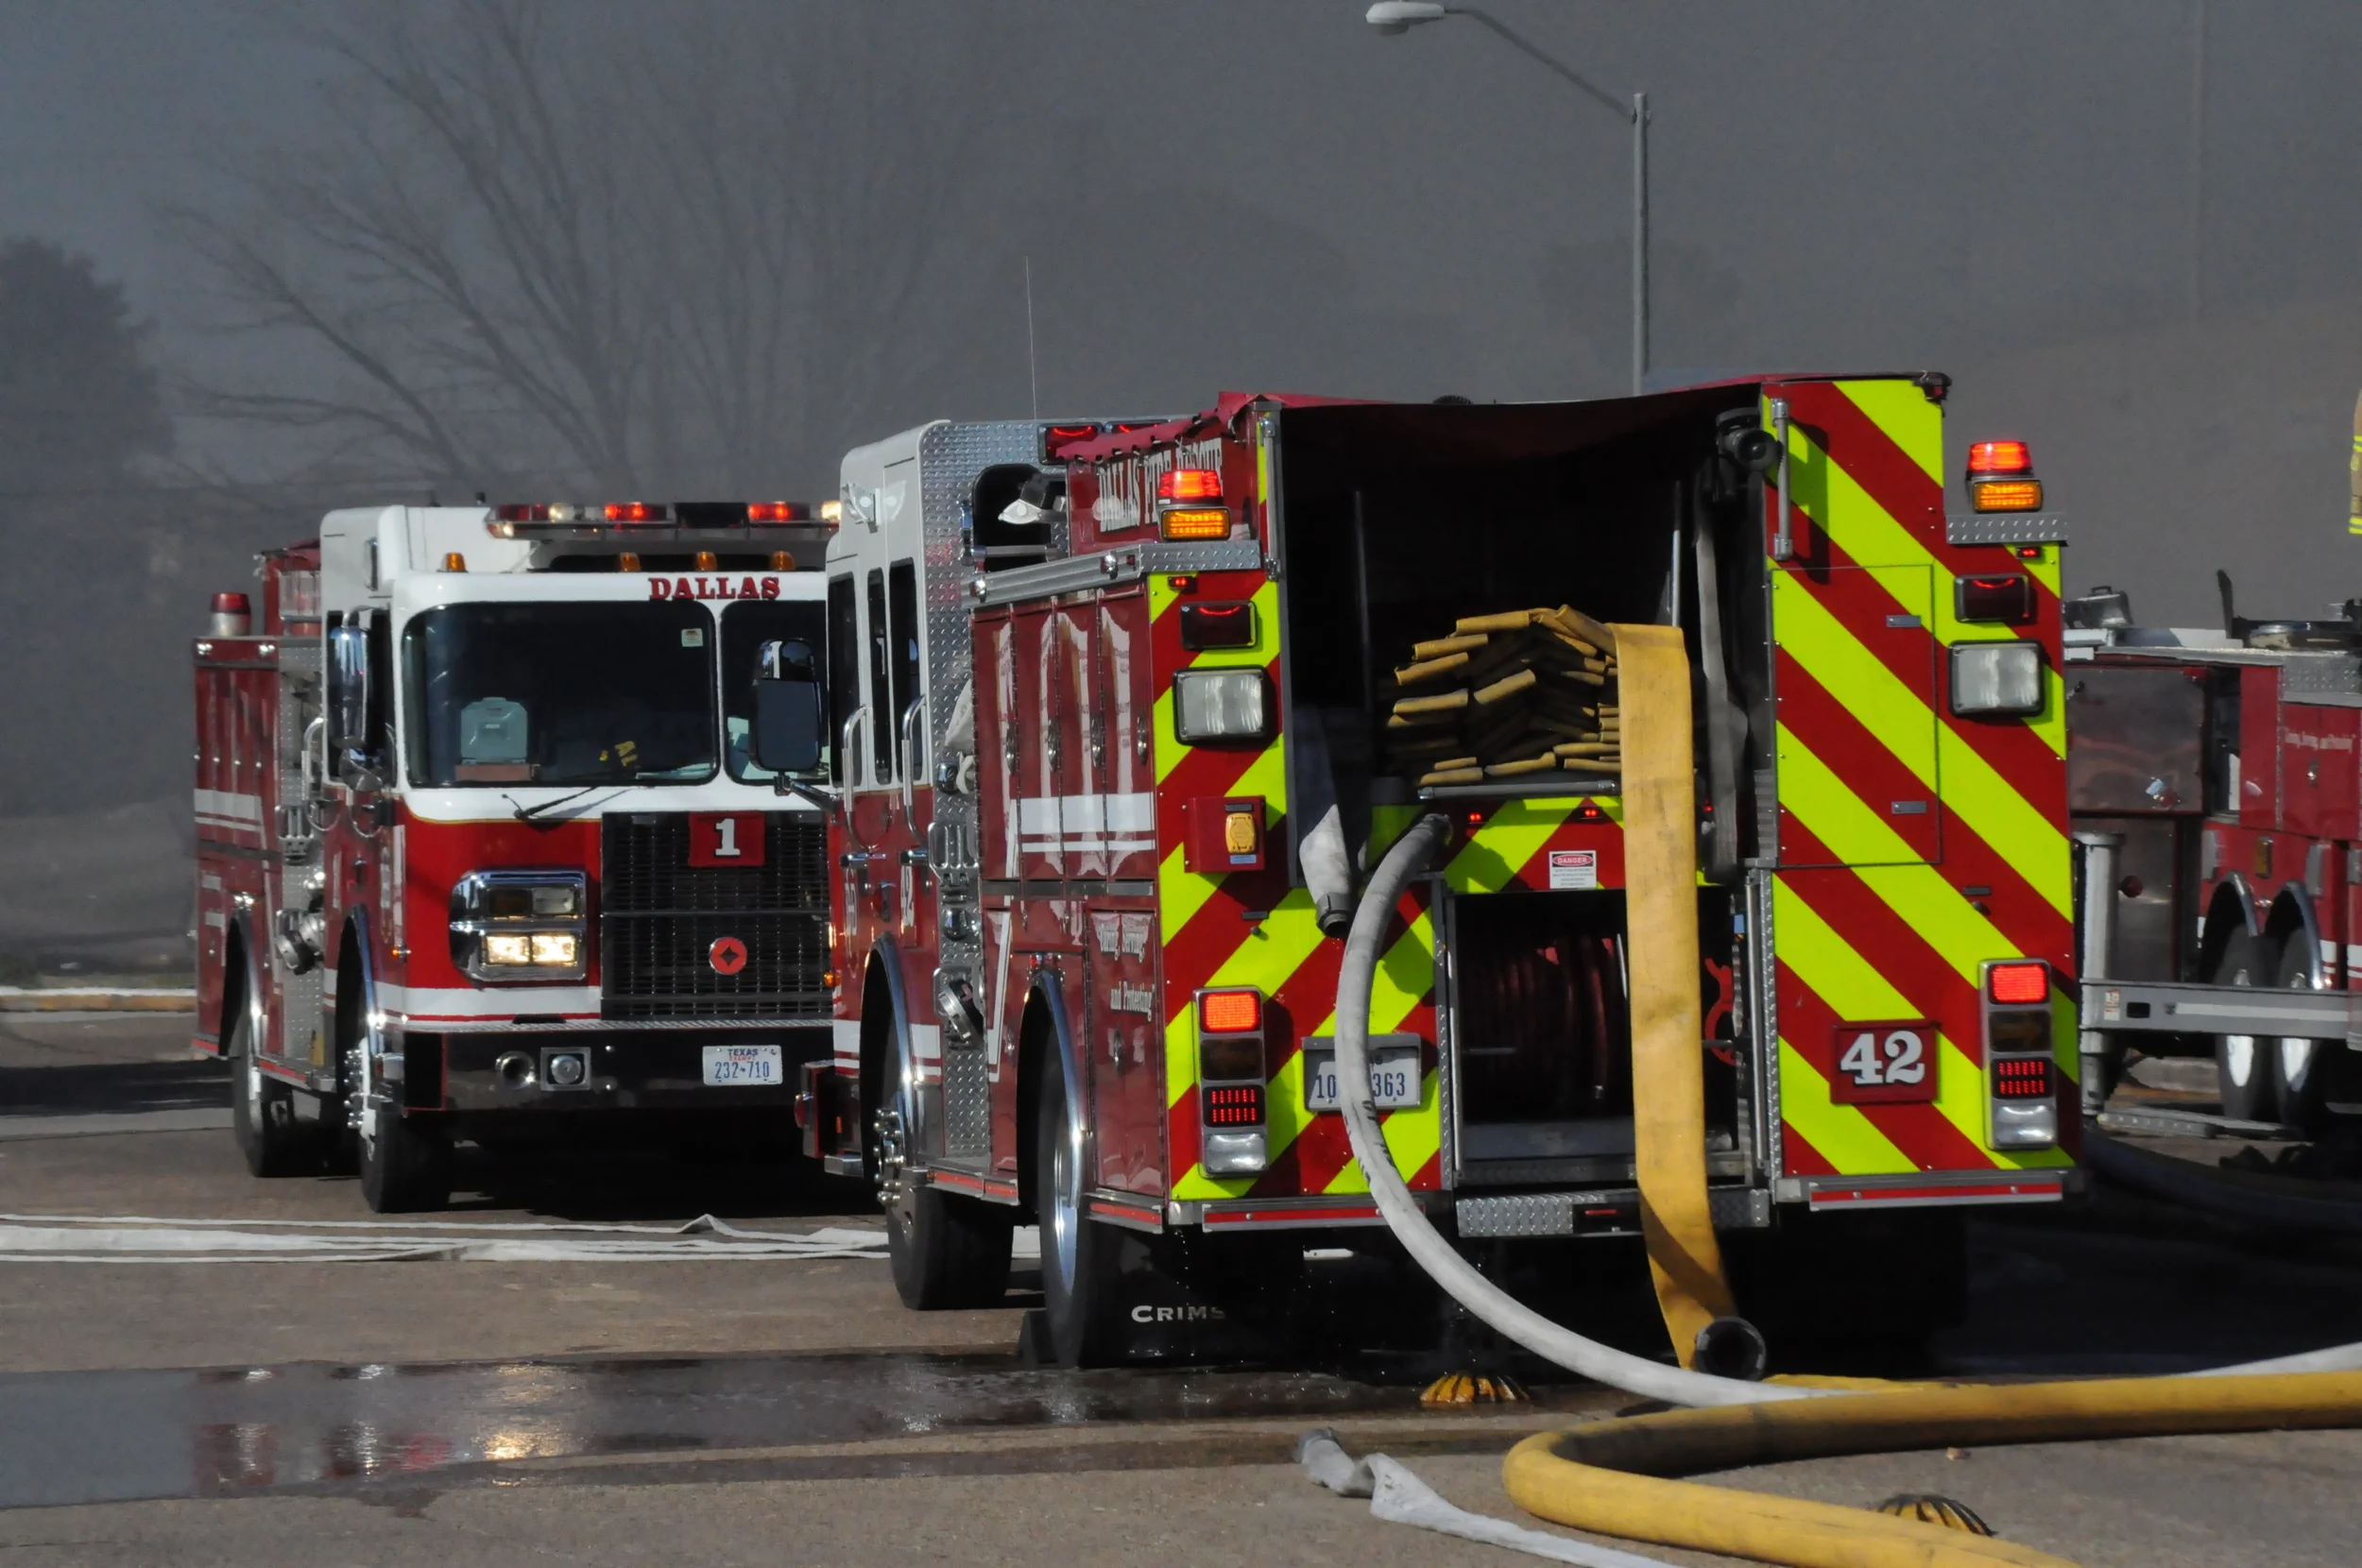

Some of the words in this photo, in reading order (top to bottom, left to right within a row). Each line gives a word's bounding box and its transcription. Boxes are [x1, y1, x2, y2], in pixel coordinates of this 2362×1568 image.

[648, 576, 780, 601] DALLAS
[715, 818, 741, 856] 1
[1840, 1030, 1926, 1084] 42
